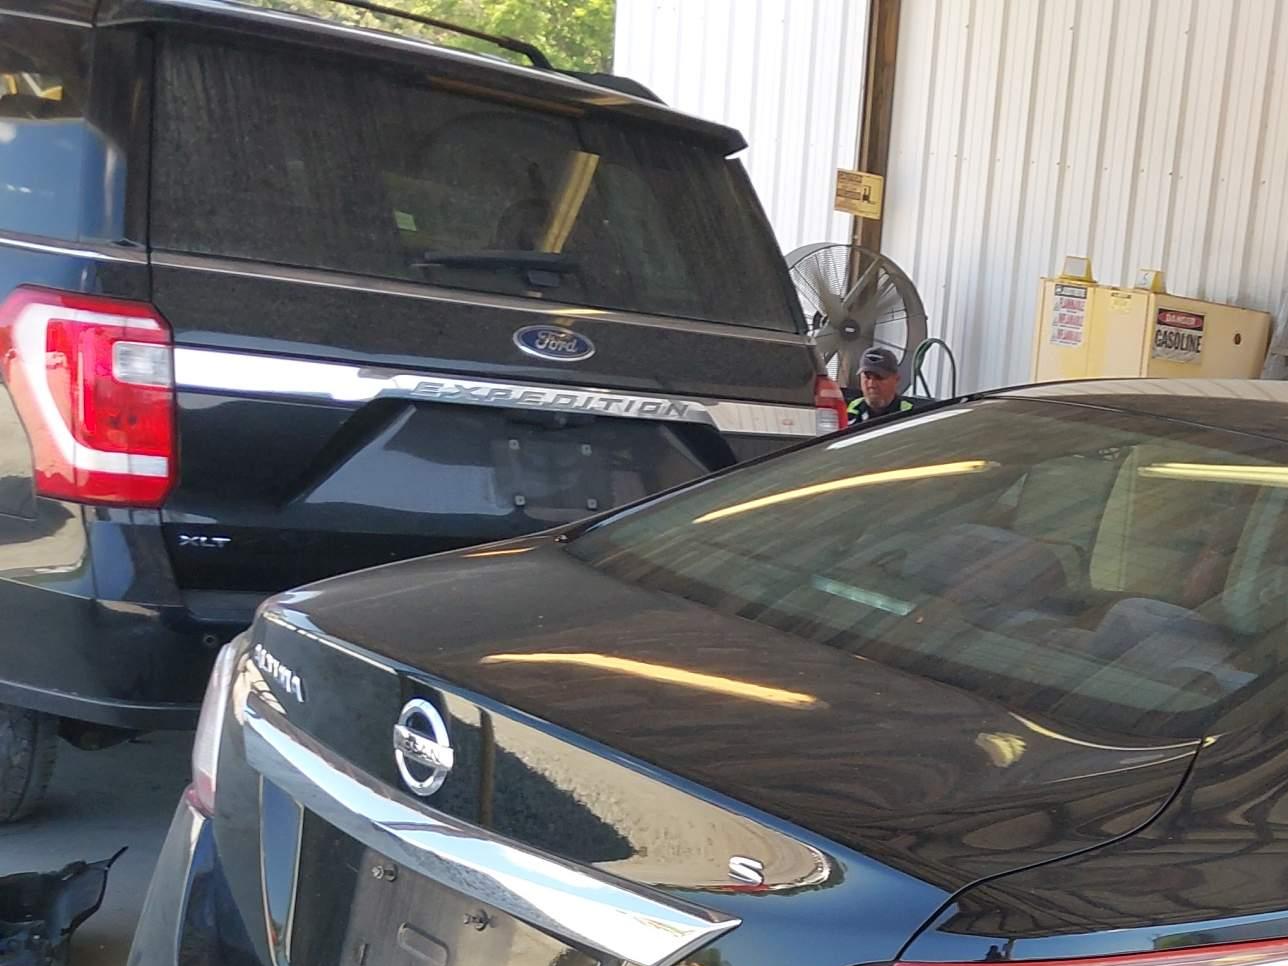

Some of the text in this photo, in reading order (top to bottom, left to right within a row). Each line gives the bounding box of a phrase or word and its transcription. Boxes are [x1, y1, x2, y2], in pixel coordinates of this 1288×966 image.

[535, 331, 578, 353] Ford
[1154, 329, 1203, 353] GASOLINE
[411, 381, 690, 417] EXPEDITION
[179, 534, 232, 548] XLT
[727, 855, 764, 885] S
